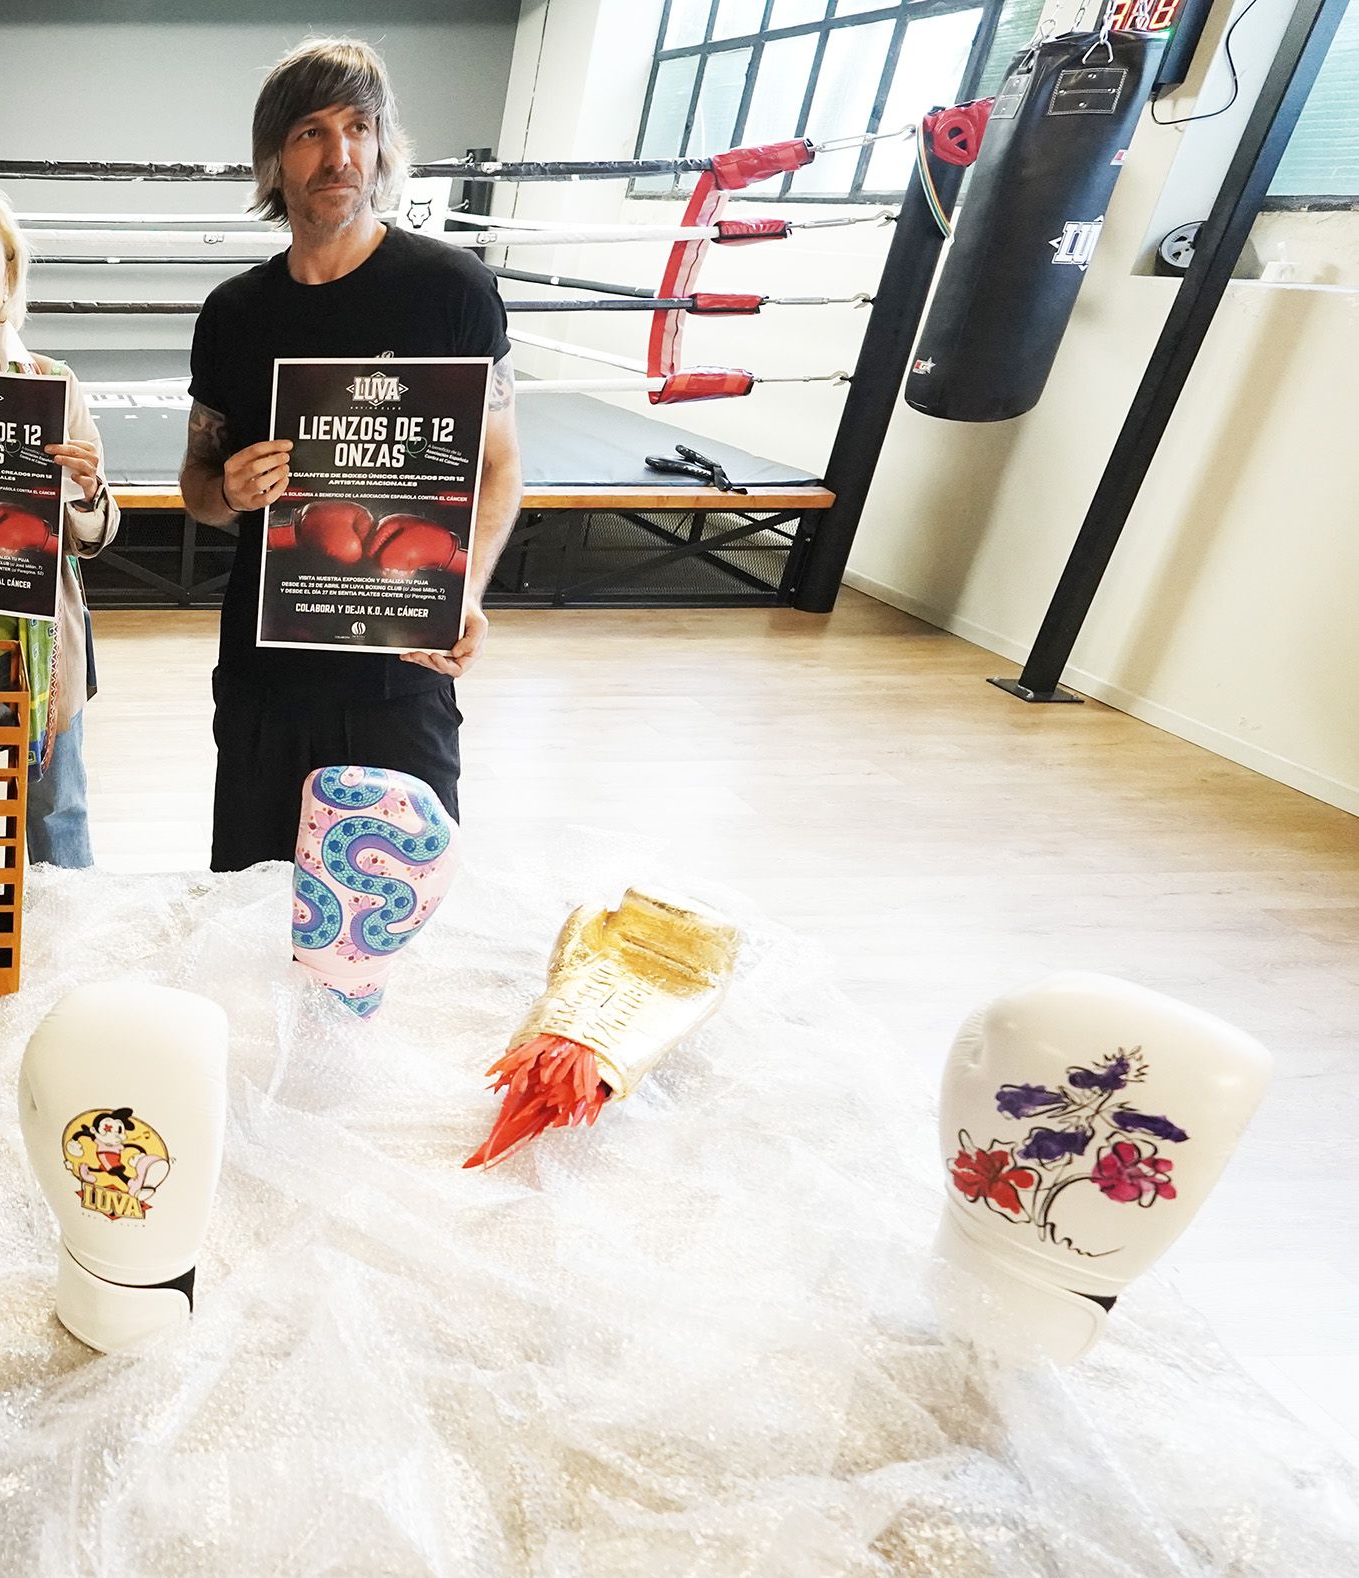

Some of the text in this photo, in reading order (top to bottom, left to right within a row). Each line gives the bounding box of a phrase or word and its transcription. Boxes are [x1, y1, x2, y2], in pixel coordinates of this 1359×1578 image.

[352, 376, 401, 401] LUVA
[23, 424, 42, 446] 12
[298, 415, 455, 443] LIENZOS DE 12
[334, 443, 406, 468] ONZAS
[296, 603, 336, 614] COLABORA
[345, 605, 365, 614] DEJA
[384, 607, 395, 616] AL
[397, 605, 429, 618] CÁNCER
[82, 1183, 145, 1219] LUVA
